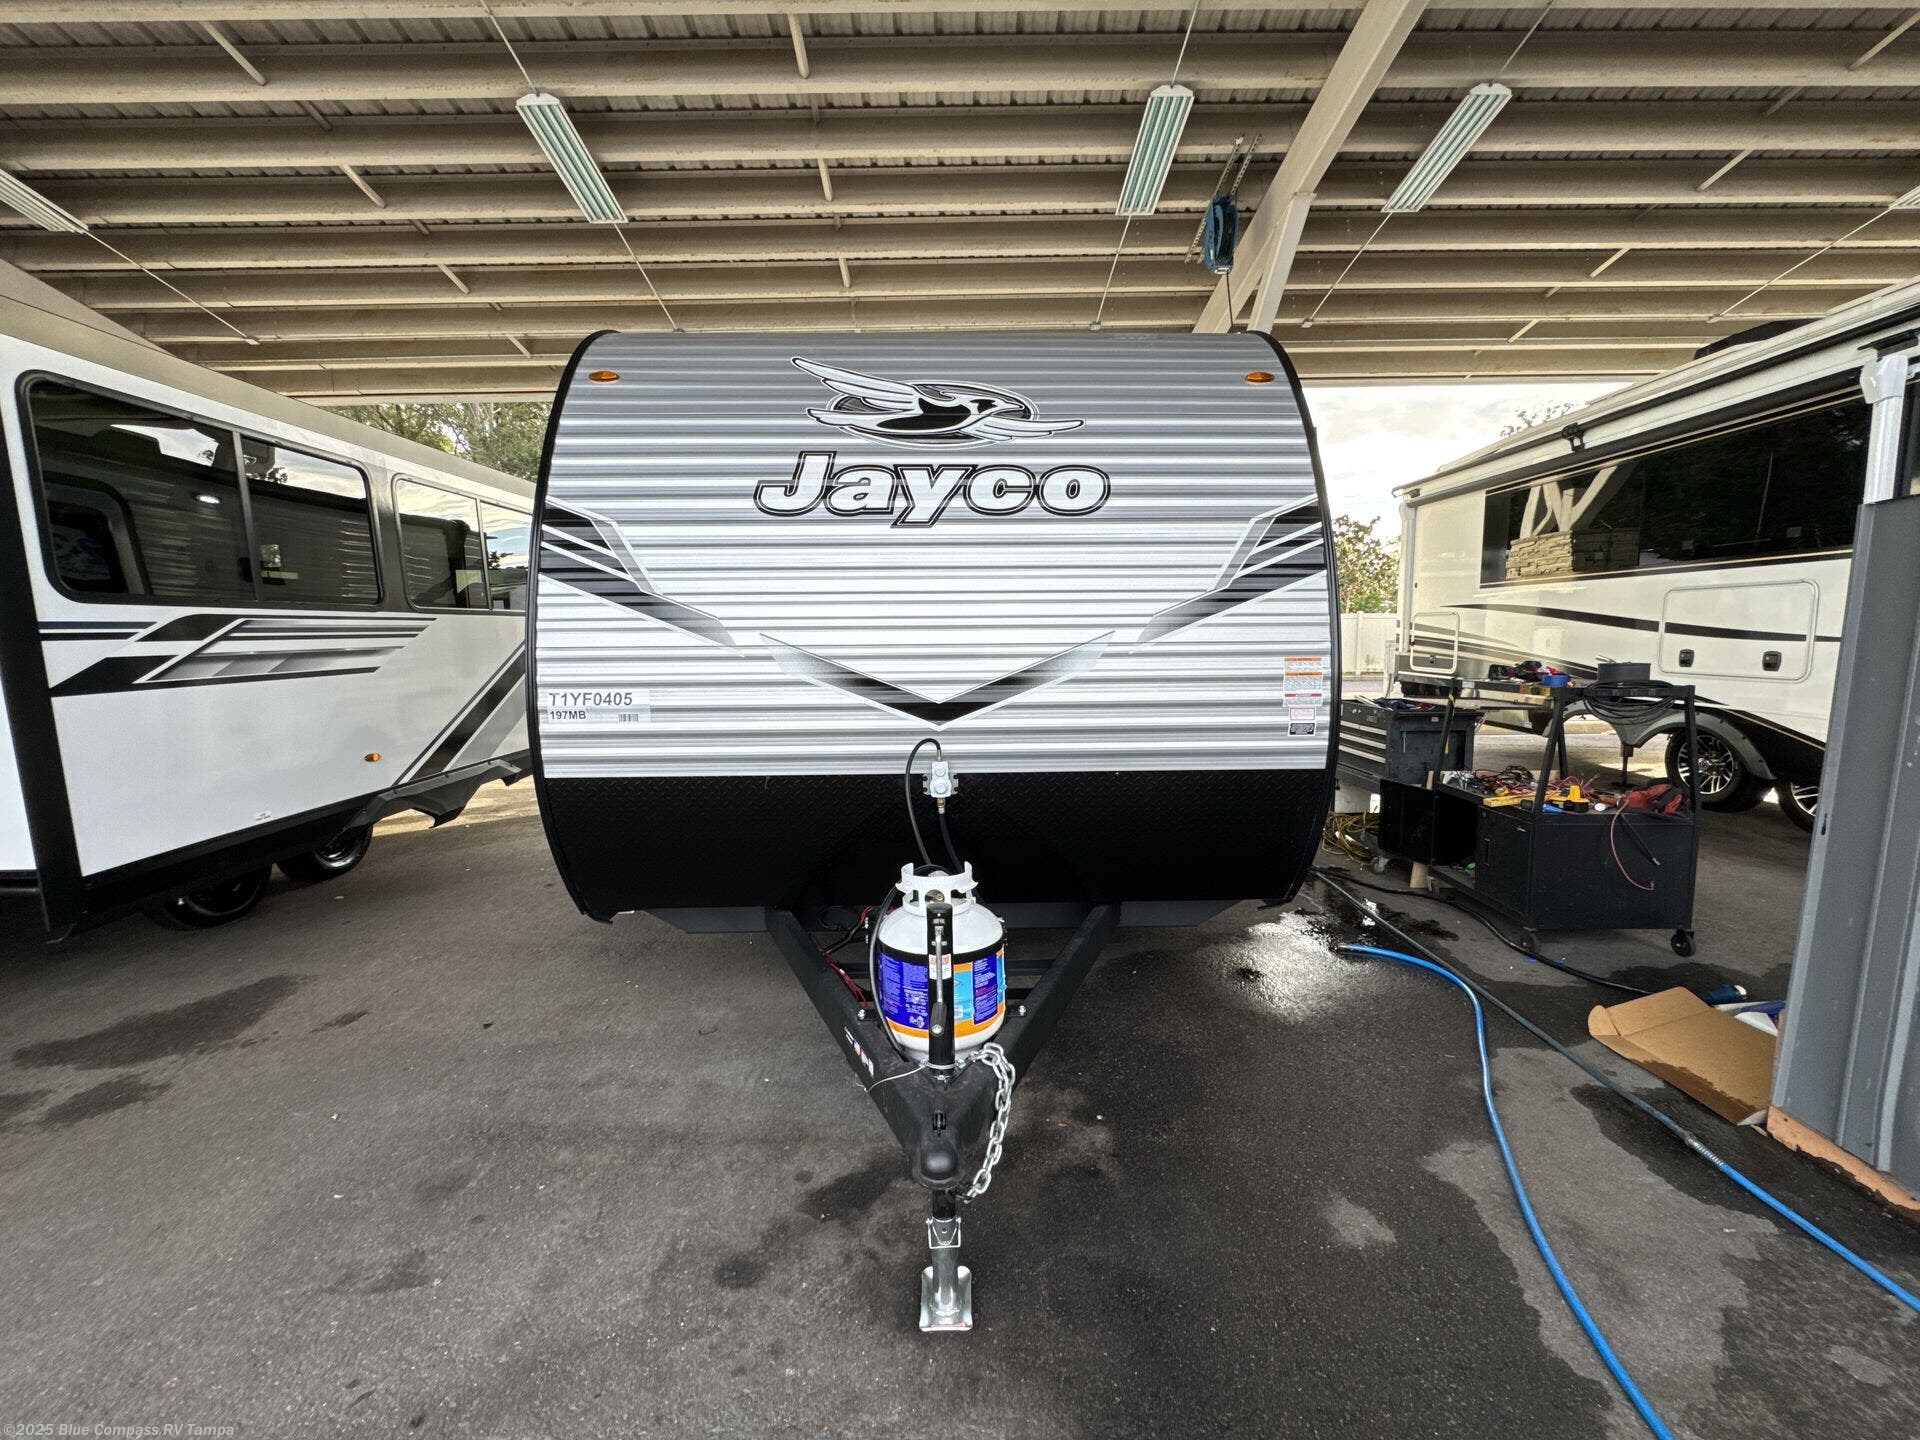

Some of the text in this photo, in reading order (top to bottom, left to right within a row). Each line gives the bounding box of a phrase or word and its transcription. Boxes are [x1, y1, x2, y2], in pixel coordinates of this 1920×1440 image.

[753, 450, 1111, 528] Jayco
[548, 692, 633, 706] T1YF0405
[549, 710, 587, 720] 197MB
